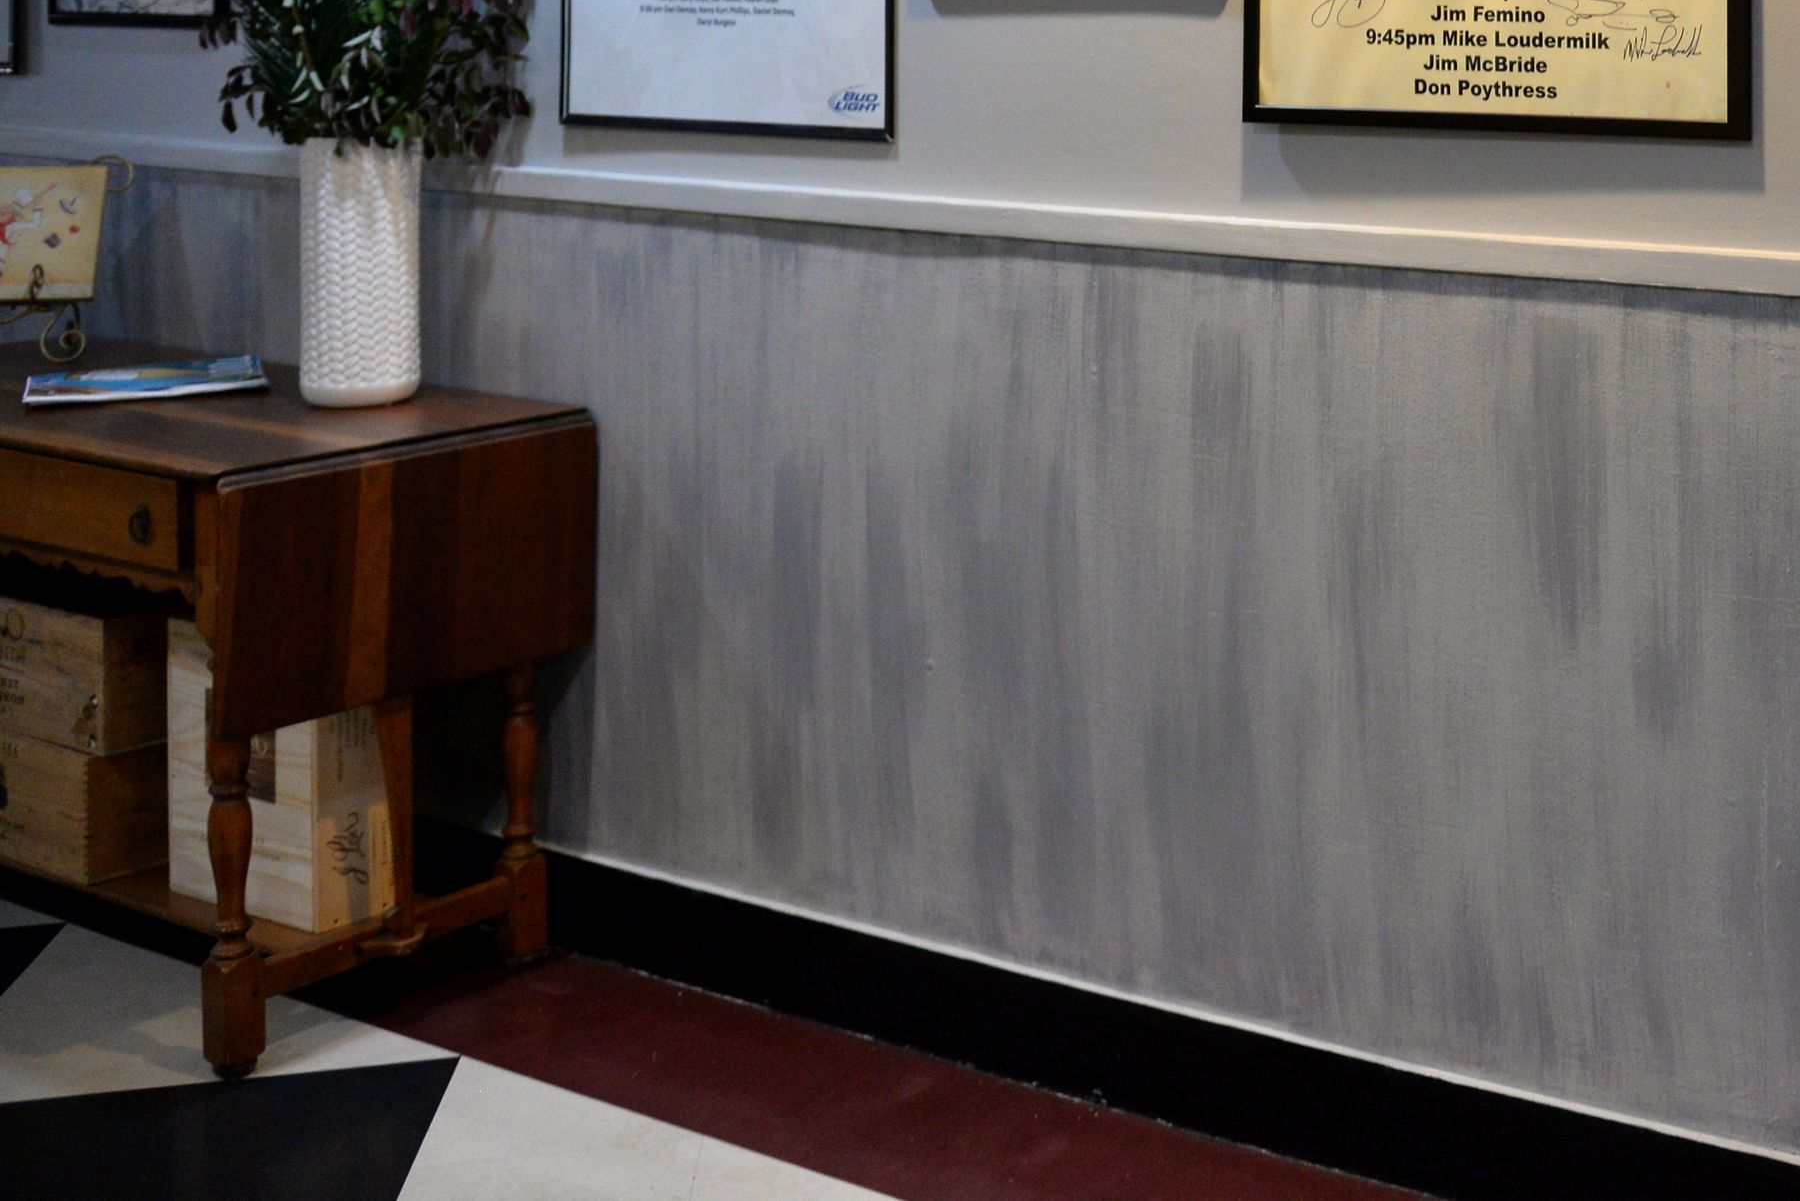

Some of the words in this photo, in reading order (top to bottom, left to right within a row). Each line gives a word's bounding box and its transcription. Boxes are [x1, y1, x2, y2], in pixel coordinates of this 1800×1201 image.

[1429, 4, 1466, 22] Jim
[1472, 4, 1545, 23] Femino
[1365, 29, 1435, 49] 9:45pm
[1442, 29, 1488, 47] Mike
[1494, 30, 1610, 50] Loudermilk
[1422, 54, 1458, 71] Jim
[1464, 54, 1547, 73] McBride
[843, 92, 878, 101] BUD
[1413, 78, 1451, 96] Don
[1457, 79, 1557, 100] Poythress
[835, 100, 880, 111] LIGHT
